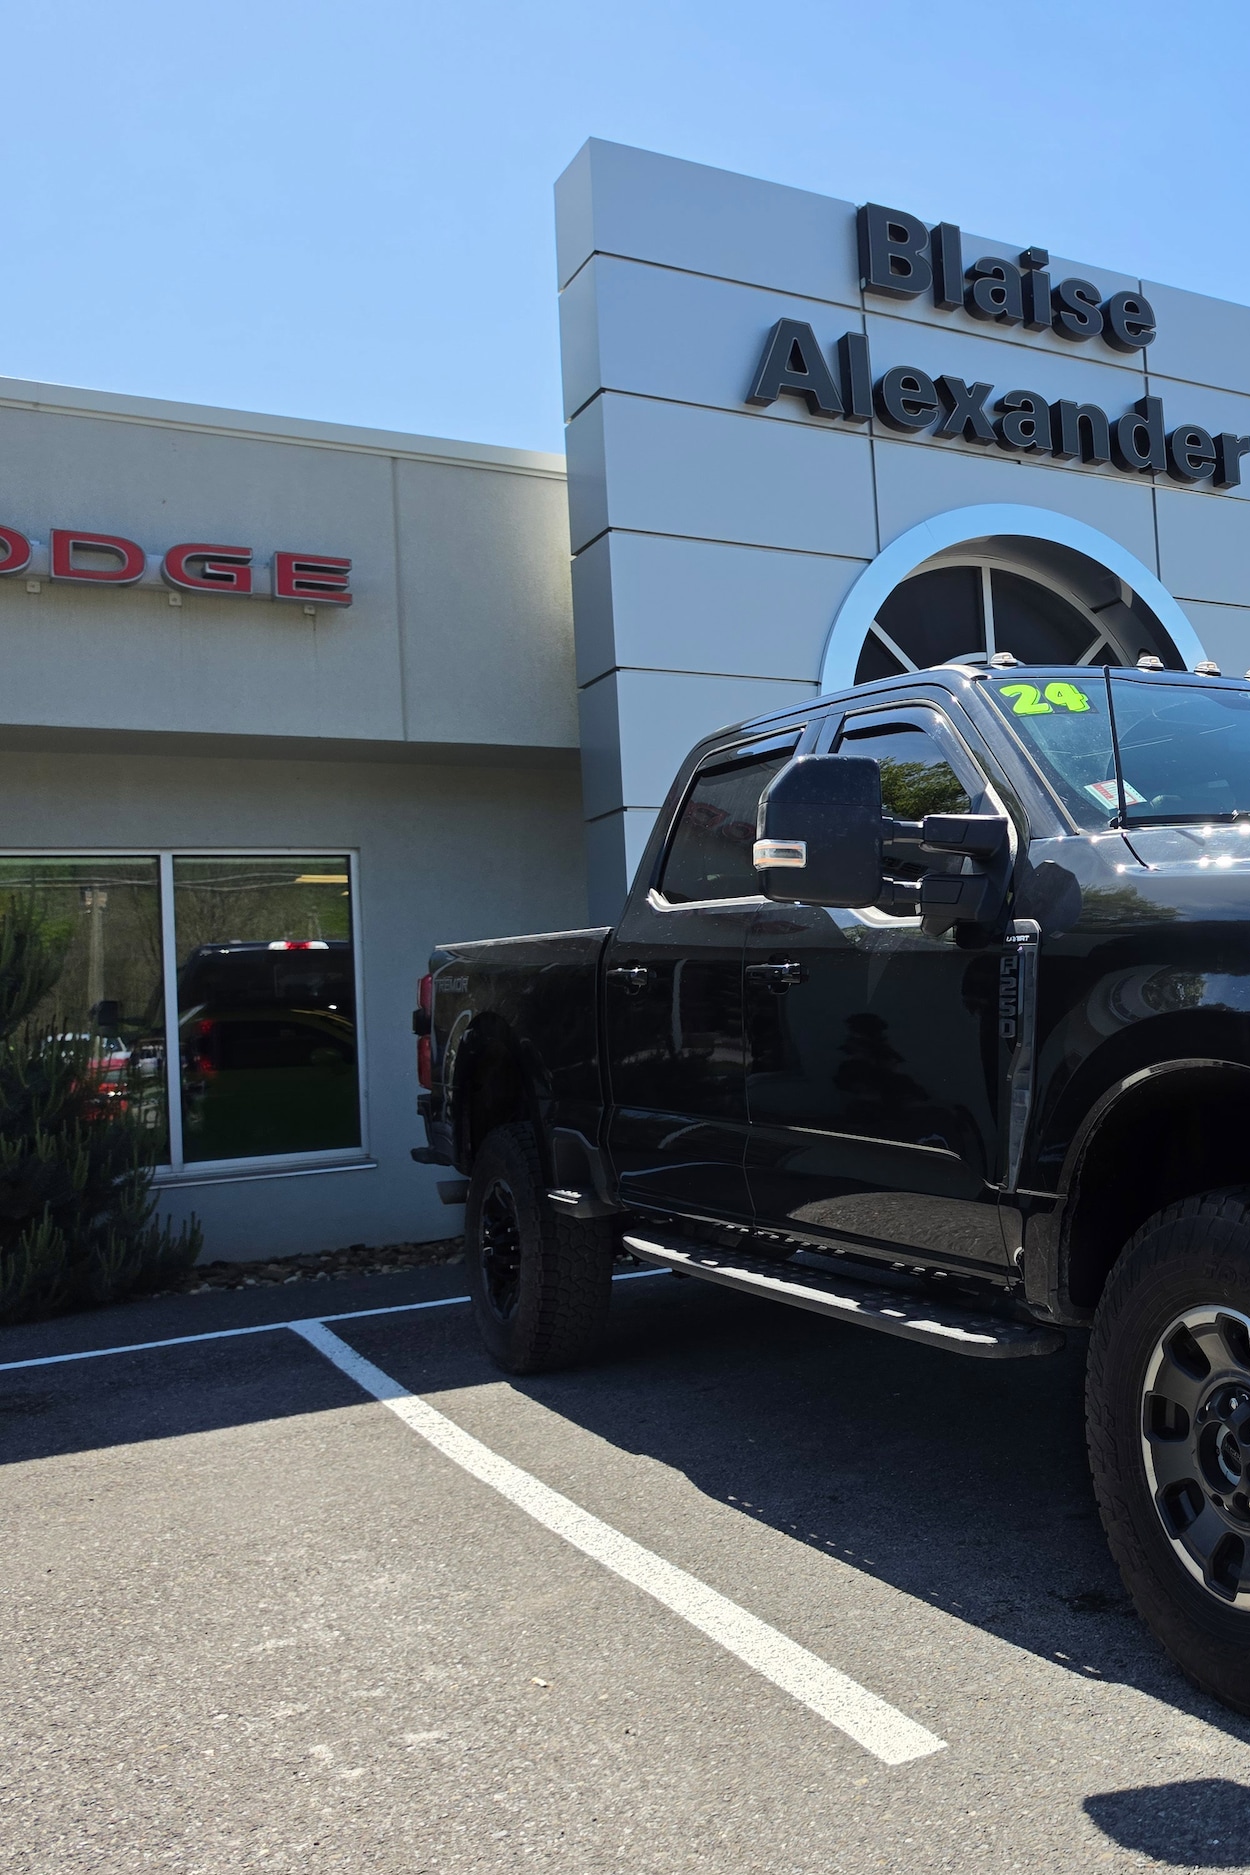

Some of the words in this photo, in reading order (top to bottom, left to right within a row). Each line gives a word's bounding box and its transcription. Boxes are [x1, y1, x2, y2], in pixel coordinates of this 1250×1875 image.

[856, 202, 1157, 354] Blaise
[999, 682, 1092, 717] 24
[434, 975, 470, 993] TREMOR
